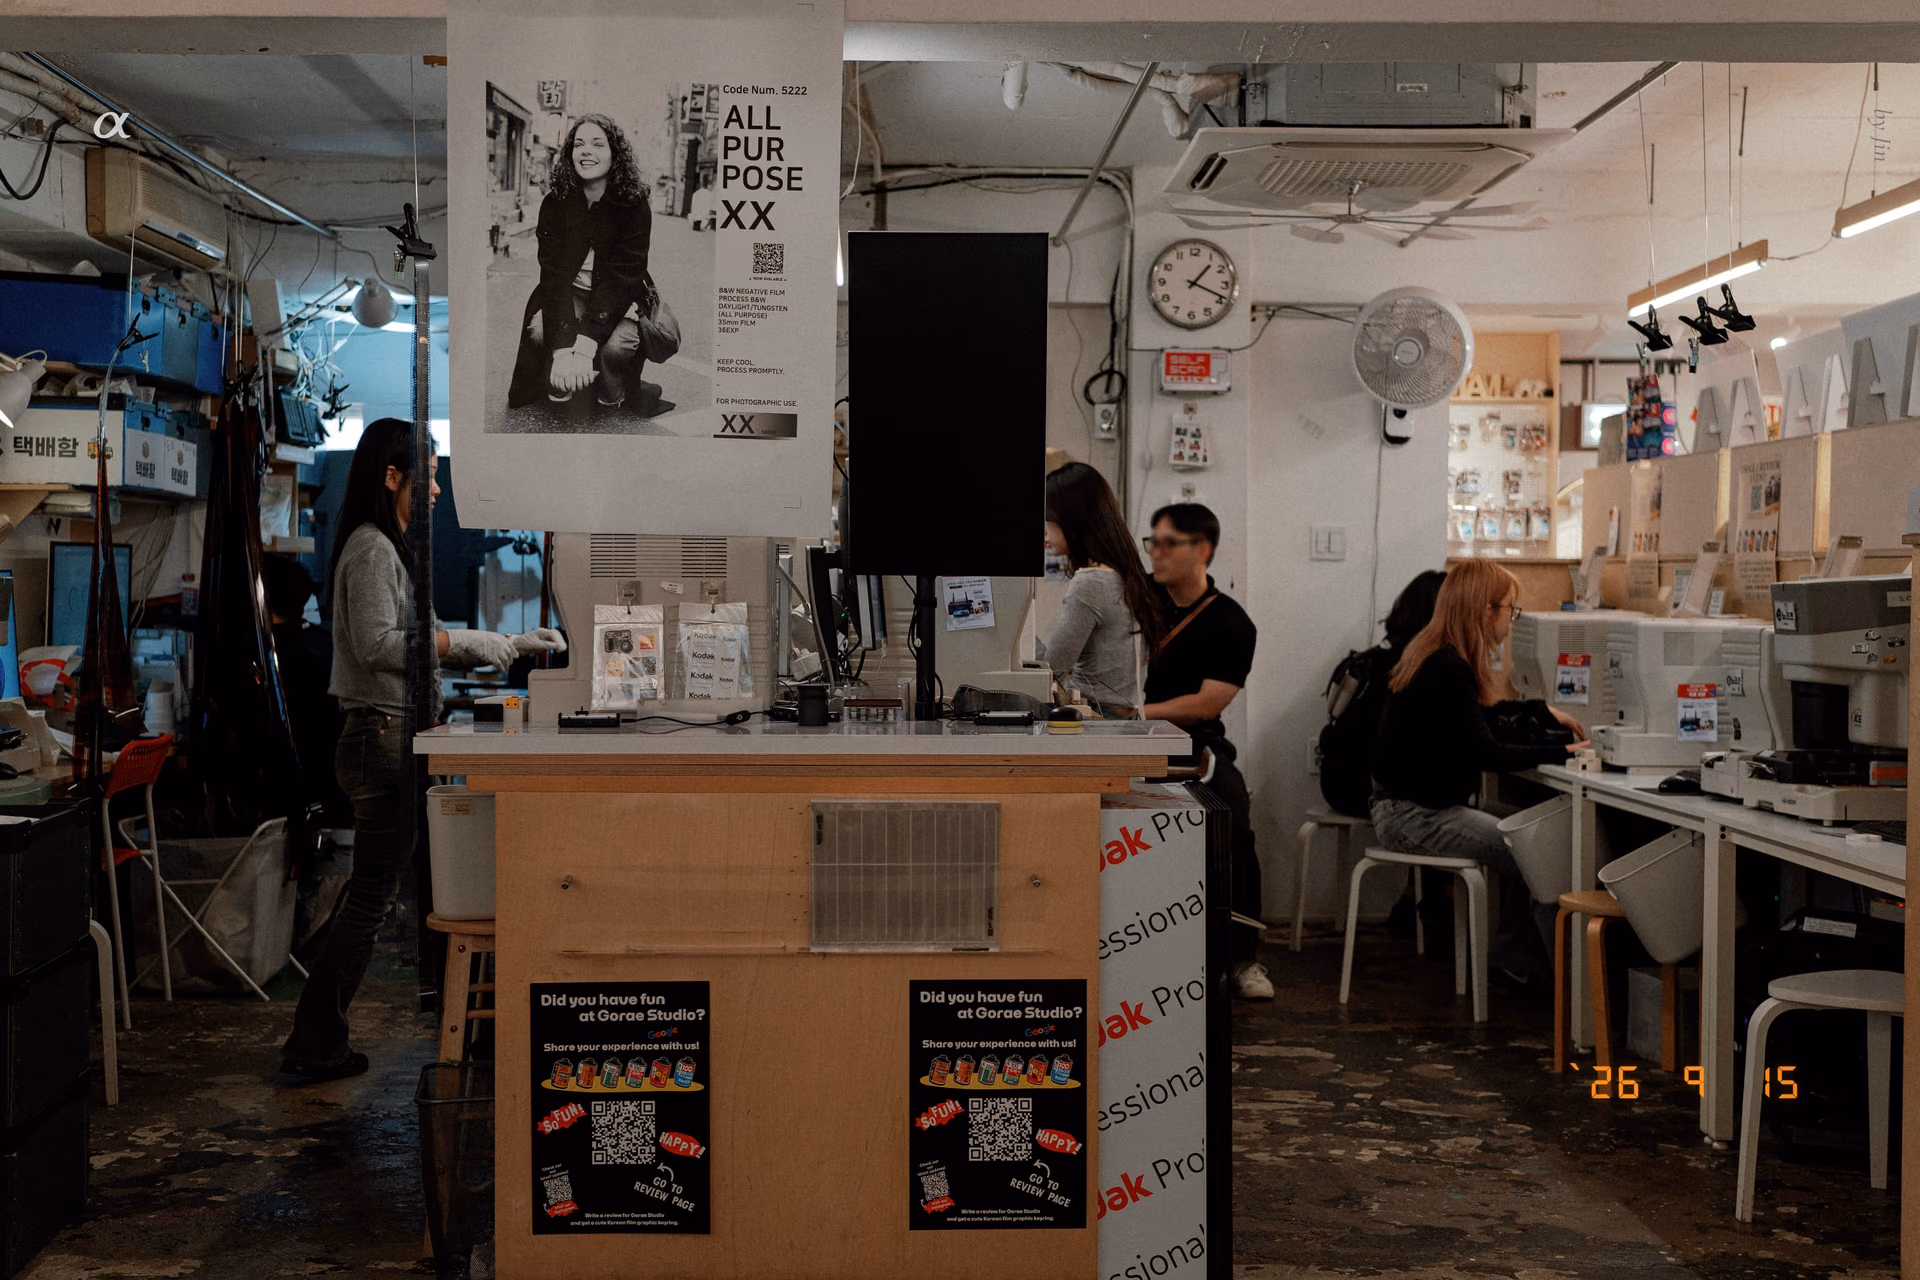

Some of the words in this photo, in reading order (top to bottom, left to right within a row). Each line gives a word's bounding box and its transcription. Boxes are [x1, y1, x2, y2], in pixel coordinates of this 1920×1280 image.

[722, 84, 748, 94] Code
[751, 86, 778, 95] Num.
[781, 86, 808, 96] 5222
[723, 104, 782, 130] ALL
[722, 136, 784, 162] PUR
[722, 164, 804, 192] POSE
[720, 200, 776, 231] XX
[1190, 248, 1200, 257] 12
[1164, 263, 1172, 272] 10
[1216, 264, 1225, 274] 2
[1158, 278, 1166, 286] 9
[1220, 280, 1229, 290] 3
[1162, 294, 1170, 302] 8
[718, 303, 788, 312] DAYLIGHT/TUNGSTEN
[1172, 305, 1180, 314] 7
[1203, 307, 1212, 316] 5
[1187, 310, 1196, 320] 6
[1170, 354, 1206, 364] SELF
[730, 398, 782, 406] PHOTOGRAPHIC
[720, 414, 755, 434] XX
[13, 436, 79, 458] 택배함
[136, 460, 156, 480] 택배함
[694, 632, 717, 640] Kodak
[692, 651, 715, 660] Kodak
[690, 671, 714, 680] Kodak
[688, 692, 712, 700] Kodak
[1100, 826, 1152, 872] ak
[1151, 810, 1204, 842] Pro
[540, 994, 566, 1006] Did
[568, 996, 596, 1008] you
[599, 994, 638, 1006] have
[640, 992, 666, 1005] fun
[920, 991, 946, 1003] Did
[948, 993, 974, 1005] you
[977, 991, 1016, 1003] have
[1018, 990, 1043, 1002] fun
[957, 1008, 974, 1019] at
[976, 1007, 1022, 1019] Gorae
[1024, 1006, 1083, 1019] Studio?
[1098, 1000, 1153, 1048] ak
[1152, 966, 1204, 1017] Pro
[578, 1010, 596, 1022] at
[598, 1010, 644, 1022] Gorae
[646, 1008, 706, 1021] Studio?
[544, 1042, 576, 1052] Share
[576, 1043, 600, 1052] your
[602, 1042, 660, 1052] experience
[660, 1041, 683, 1050] with
[684, 1041, 700, 1050] us!
[922, 1040, 954, 1048] Share
[954, 1040, 978, 1049] your
[979, 1039, 1036, 1050] experience
[1038, 1039, 1060, 1048] with
[1061, 1039, 1076, 1048] us!
[659, 1132, 706, 1159] HAPPY!
[1036, 1128, 1083, 1156] HAPPY!
[652, 1176, 667, 1188] GO
[671, 1183, 683, 1194] TO
[1029, 1173, 1044, 1184] GO
[1047, 1180, 1060, 1190] TO
[1098, 1172, 1154, 1220] ak
[1152, 1138, 1204, 1189] Pro
[634, 1181, 669, 1202] REVIEW
[672, 1196, 696, 1212] PAGE
[1010, 1178, 1046, 1198] REVIEW
[1048, 1192, 1072, 1208] PAGE
